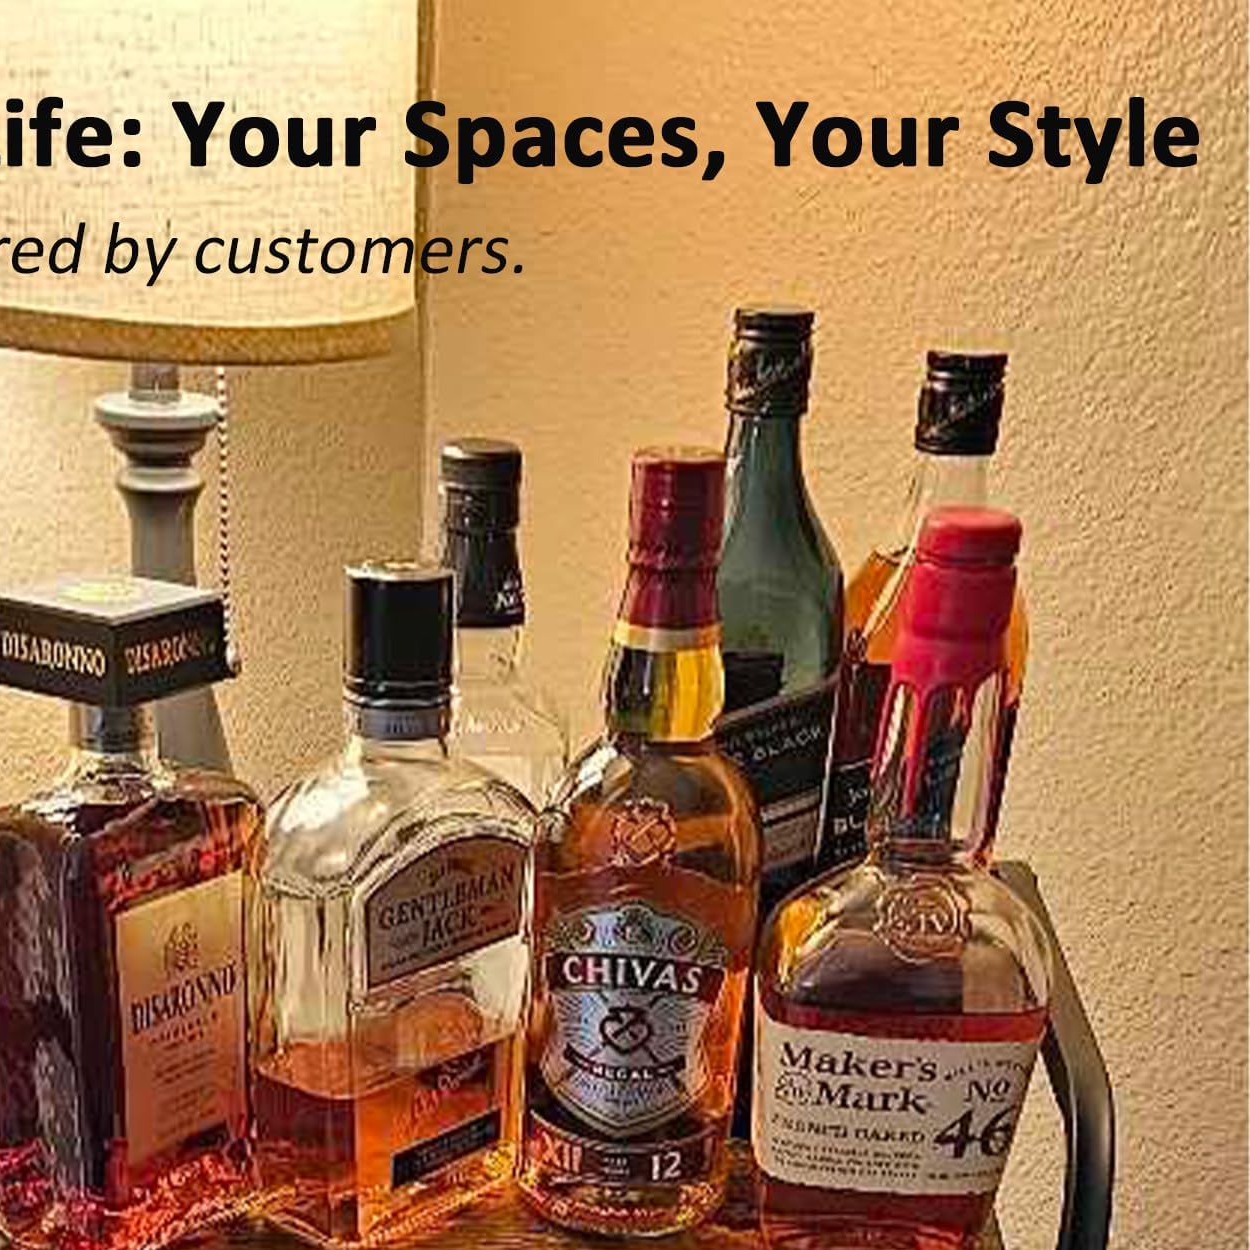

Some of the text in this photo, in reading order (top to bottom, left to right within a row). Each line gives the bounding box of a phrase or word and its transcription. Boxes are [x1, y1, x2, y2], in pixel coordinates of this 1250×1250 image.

[1, 629, 107, 679] DISARONNO
[562, 954, 703, 994] CHIVAS
[779, 1041, 938, 1083] Maker's
[813, 1079, 928, 1115] Mark
[933, 1103, 1019, 1160] 46
[651, 1150, 682, 1181] 12
